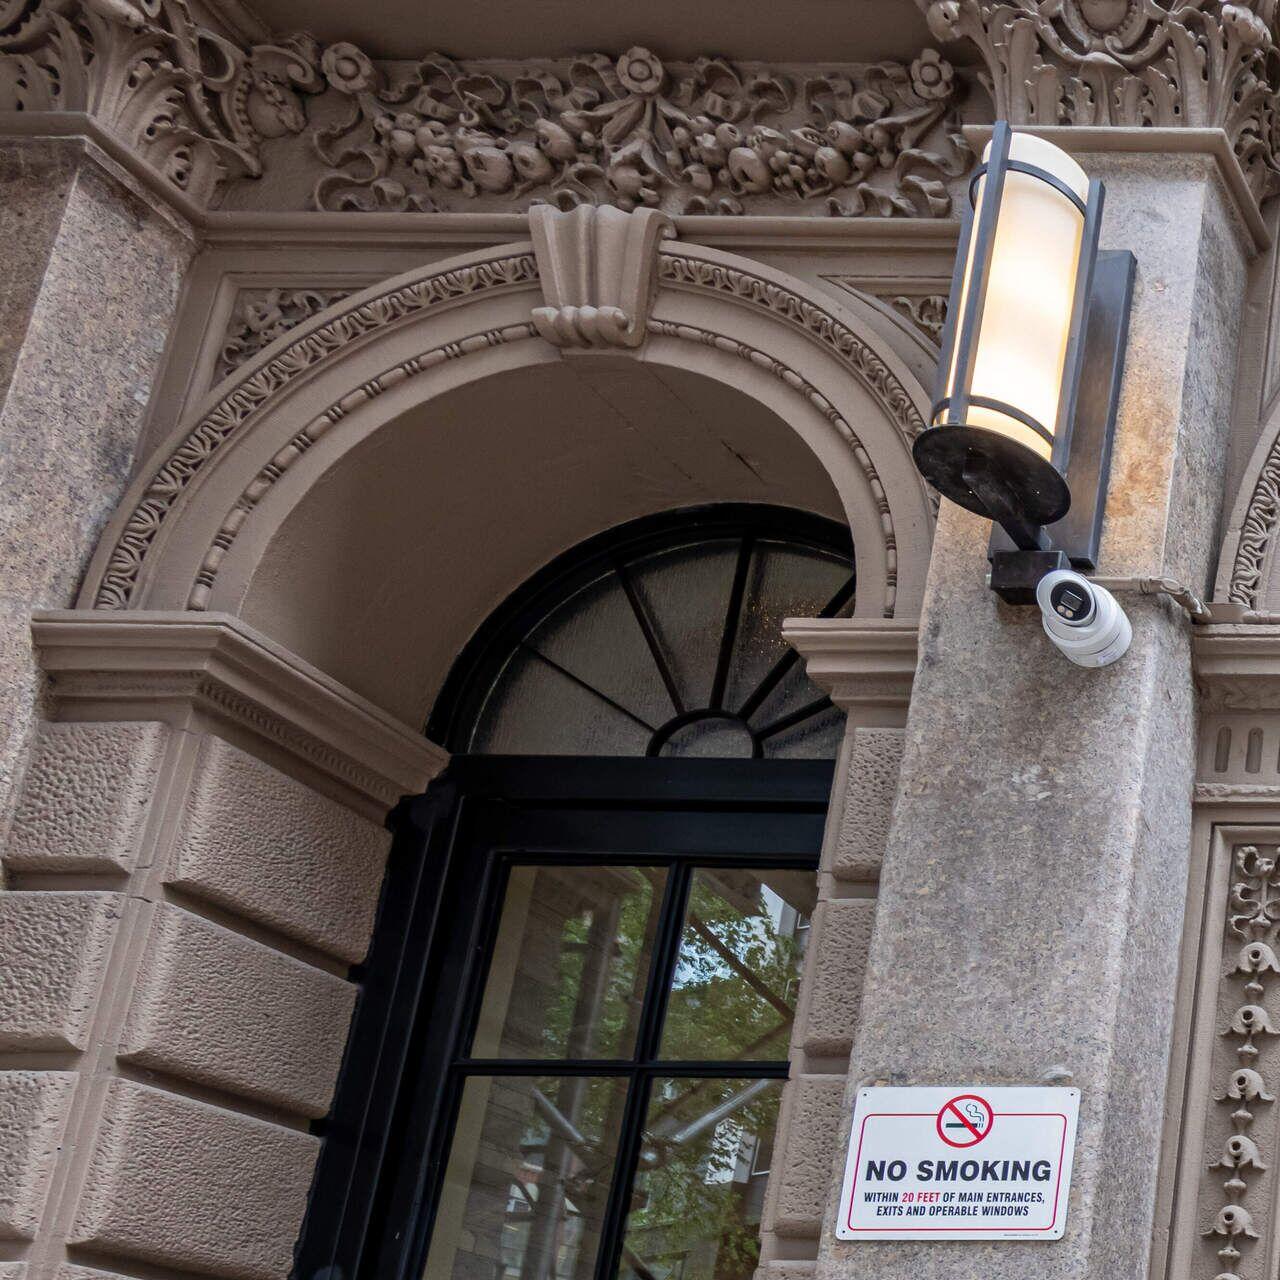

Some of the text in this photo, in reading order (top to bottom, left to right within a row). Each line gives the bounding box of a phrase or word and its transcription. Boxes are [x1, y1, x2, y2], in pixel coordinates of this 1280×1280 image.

[865, 1160, 1051, 1182] NO SMOKING
[864, 1192, 1045, 1204] WITHIN 20 FEET OF MAIN ENTRANCES,
[876, 1205, 1029, 1216] EXITS AND OPERABLE WINDOWS
